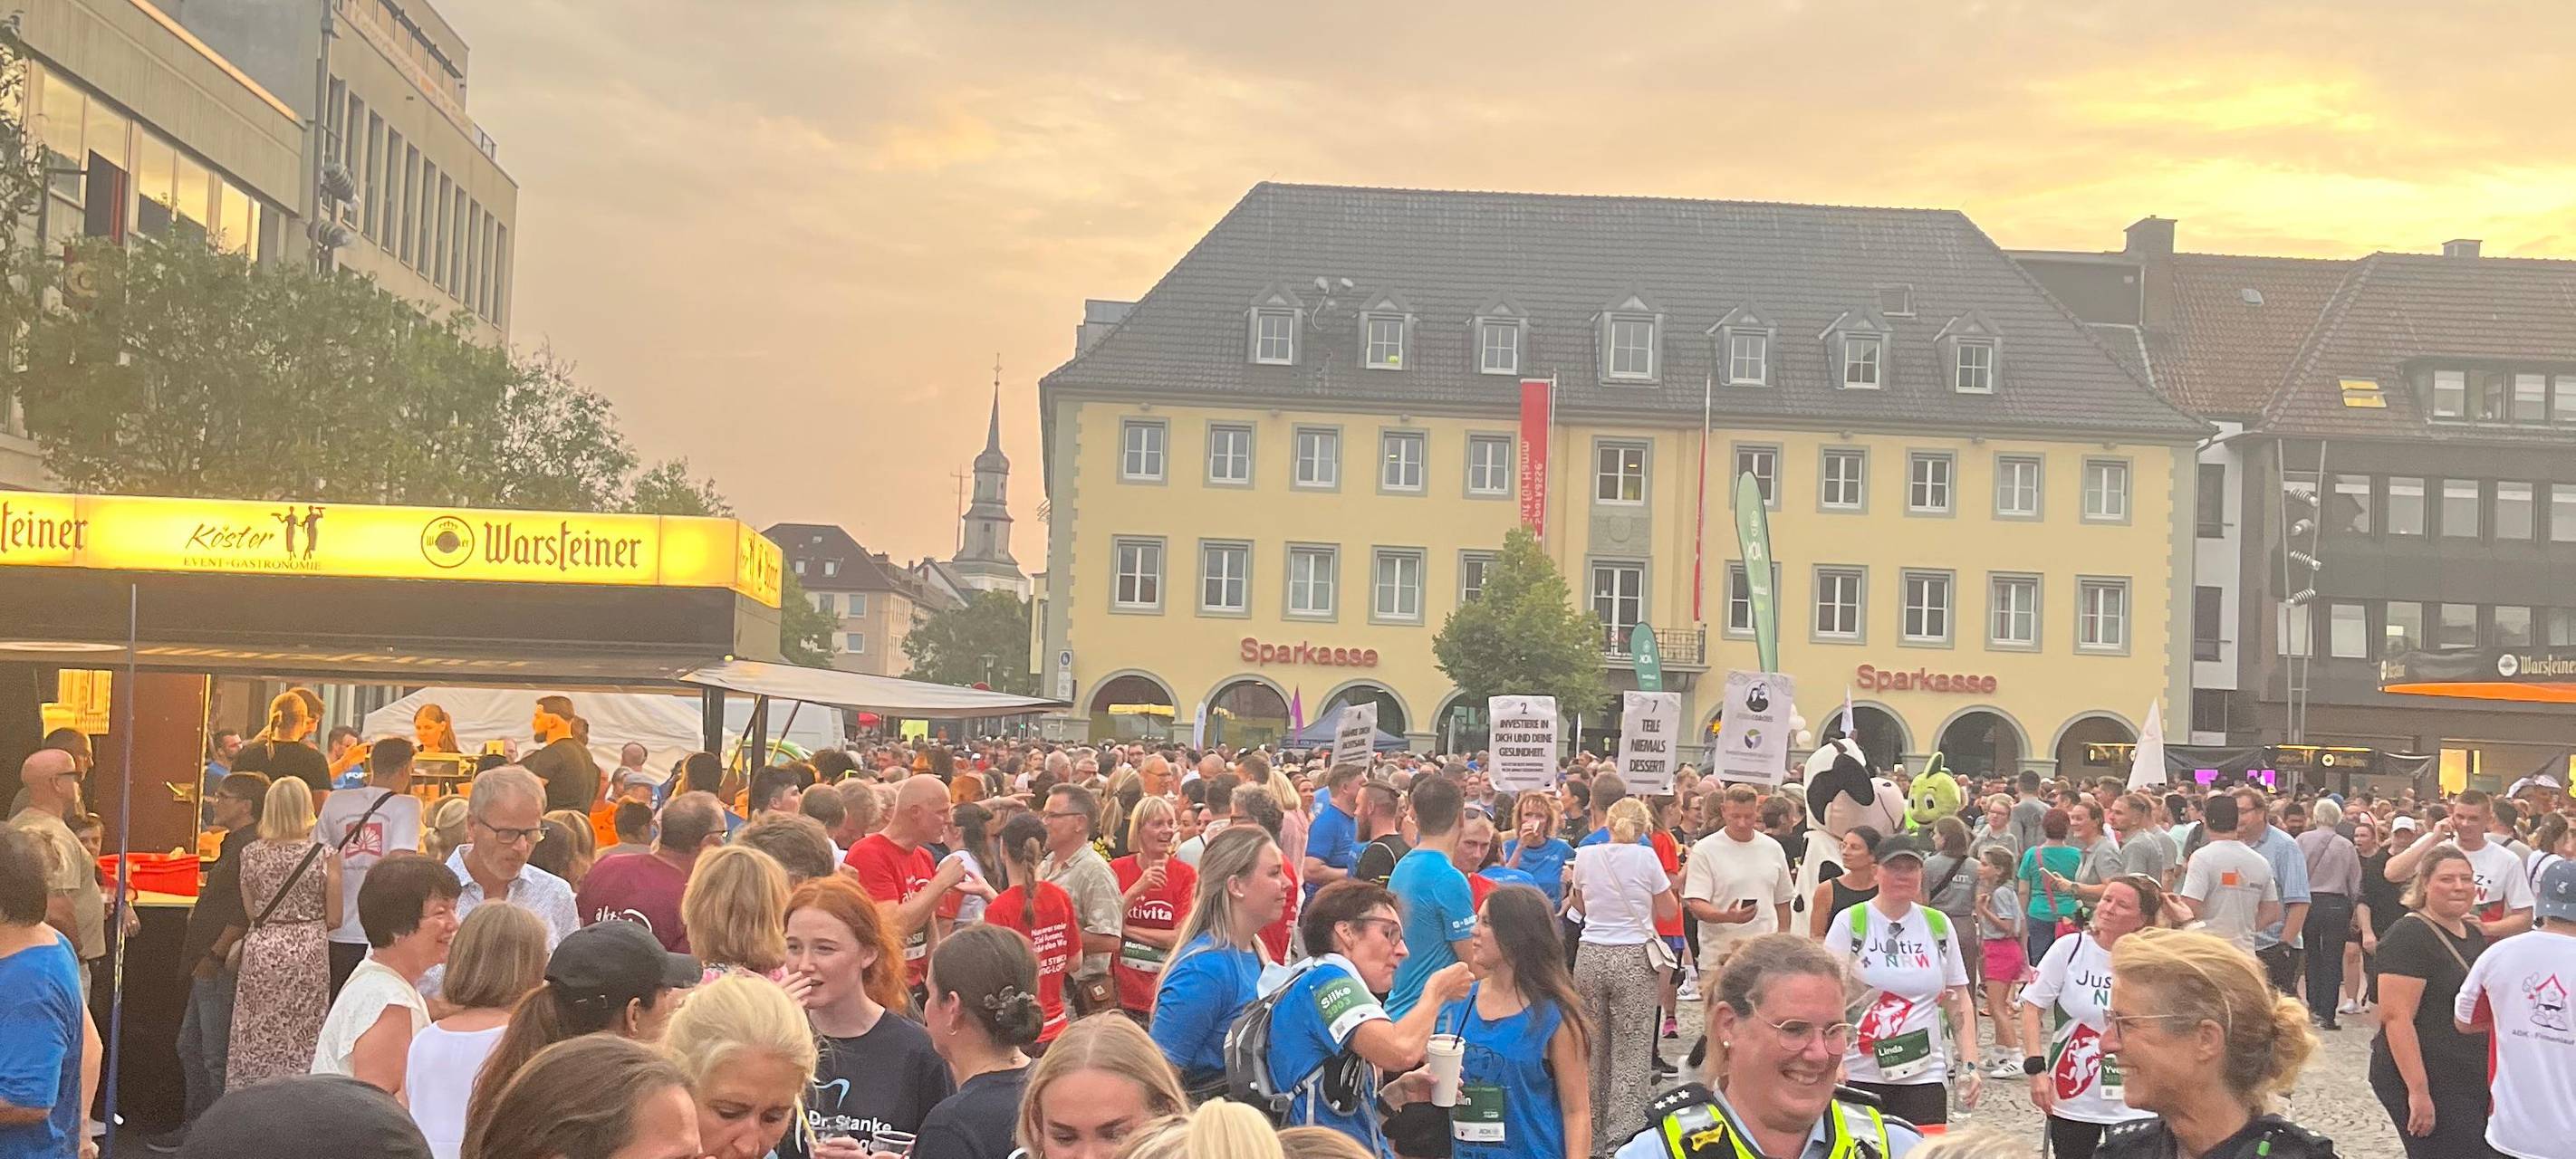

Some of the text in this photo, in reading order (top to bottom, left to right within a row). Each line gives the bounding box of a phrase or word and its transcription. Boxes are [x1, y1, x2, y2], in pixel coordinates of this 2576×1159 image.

[186, 523, 274, 551] Köster
[484, 521, 641, 572] Warsteiner
[1241, 637, 1379, 667] Sparkasse
[1857, 664, 1997, 694] Sparkasse
[1521, 703, 1527, 714] 2
[1651, 700, 1658, 714] 7
[1500, 719, 1549, 729] INVESTIERE IN
[1642, 719, 1660, 733] TEILE
[1495, 733, 1552, 742] DICH UND DEINE
[1630, 739, 1666, 752] NIEMALS
[1869, 938, 1923, 954] Jutiz
[1321, 987, 1351, 1009] Silke
[1879, 1045, 1903, 1056] Linda
[809, 1110, 891, 1133] Dr. Stanke
